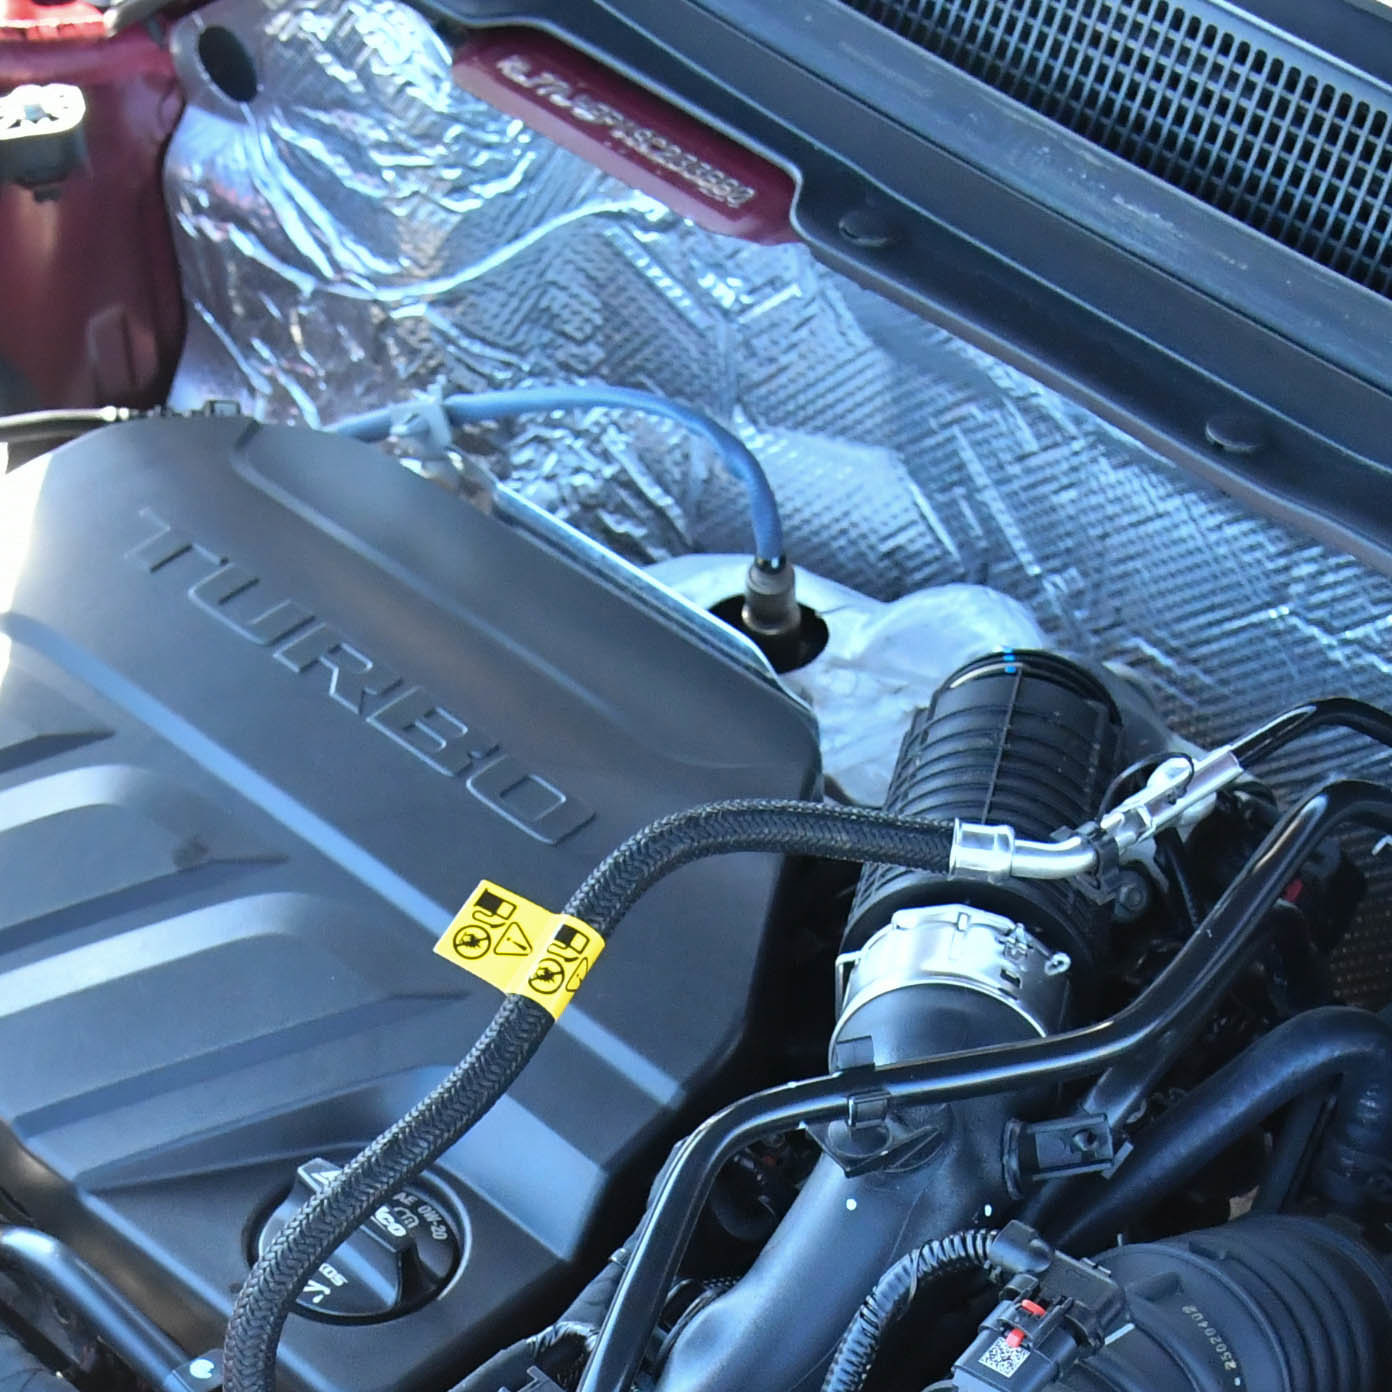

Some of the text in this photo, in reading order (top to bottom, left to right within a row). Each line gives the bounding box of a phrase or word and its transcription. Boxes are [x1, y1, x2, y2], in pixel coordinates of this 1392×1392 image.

[123, 506, 598, 847] TURBO
[393, 1191, 419, 1206] AE
[418, 1203, 449, 1241] 0W-20
